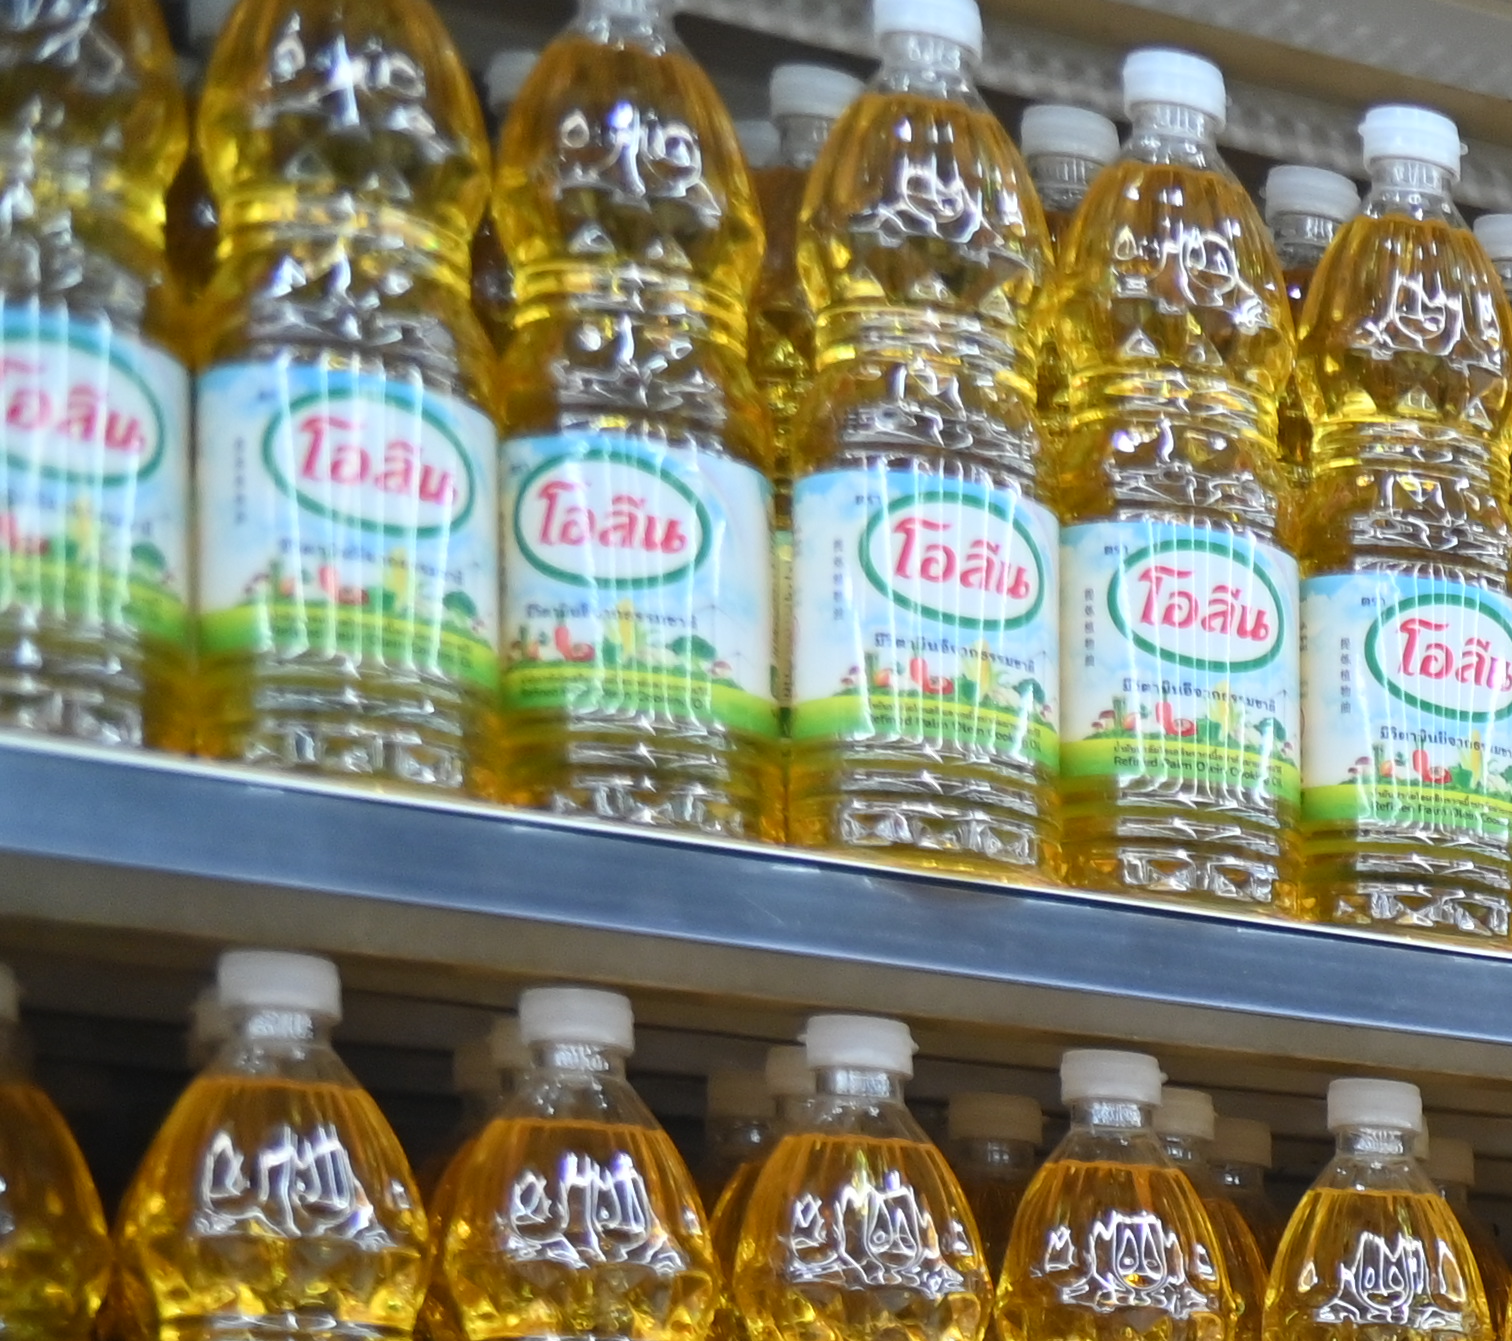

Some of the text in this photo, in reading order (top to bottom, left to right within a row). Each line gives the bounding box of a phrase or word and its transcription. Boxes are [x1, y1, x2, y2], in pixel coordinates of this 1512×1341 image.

[3, 372, 146, 455] อลีน
[302, 415, 455, 507] โอลีน
[539, 480, 687, 554] โอลีน
[895, 517, 1029, 599] โอลีน
[1141, 566, 1268, 640] โอลีน
